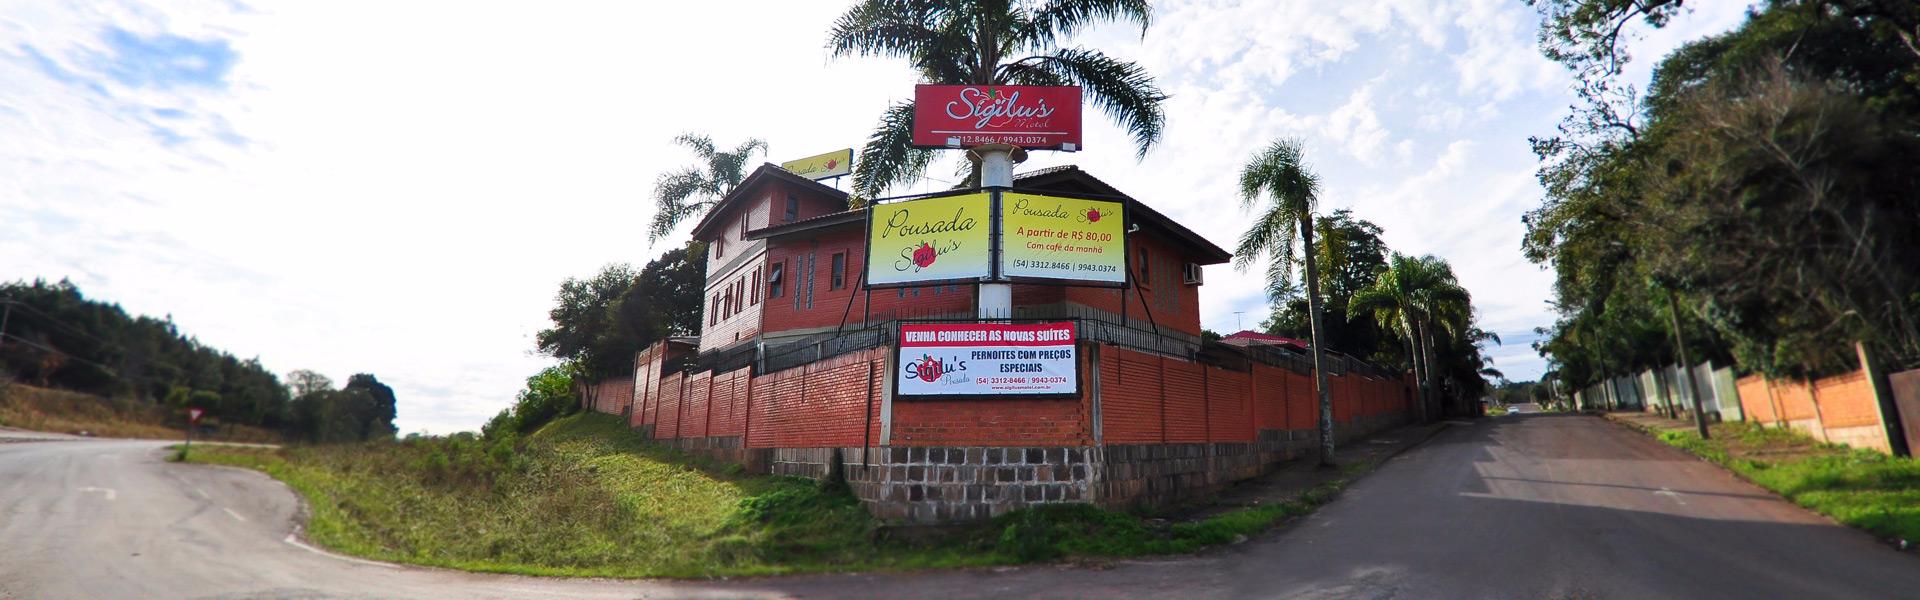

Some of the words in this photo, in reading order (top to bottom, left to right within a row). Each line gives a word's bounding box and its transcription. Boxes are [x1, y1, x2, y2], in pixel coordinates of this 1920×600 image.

[946, 87, 1055, 129] Sigilu's
[952, 135, 995, 143] 12.8466
[1003, 135, 1047, 144] 9943.0374
[1013, 199, 1070, 219] Pousada
[882, 207, 978, 238] Pousada
[1017, 226, 1024, 235] A
[1027, 228, 1054, 238] partir
[1057, 230, 1069, 239] de
[1071, 230, 1083, 241] R$
[1086, 231, 1112, 242] 80,00
[1026, 241, 1044, 250] Com
[1046, 243, 1062, 252] café
[1064, 243, 1074, 252] da
[1076, 245, 1103, 254] manhã
[1013, 259, 1028, 269] (54)
[1031, 260, 1070, 270] 3312.8466
[1078, 263, 1116, 273] 9943.0374
[906, 331, 936, 342] VENHA
[938, 331, 986, 342] CONHECER
[989, 331, 1001, 341] AS
[1003, 331, 1035, 342] NOVAS
[1036, 328, 1070, 341] SUÍTES
[971, 351, 1016, 360] PERNOITES
[1018, 351, 1037, 360] COM
[1039, 350, 1071, 361] PREÇOS
[905, 356, 967, 382] Sigilu's
[1000, 363, 1043, 373] ESPECIAIS
